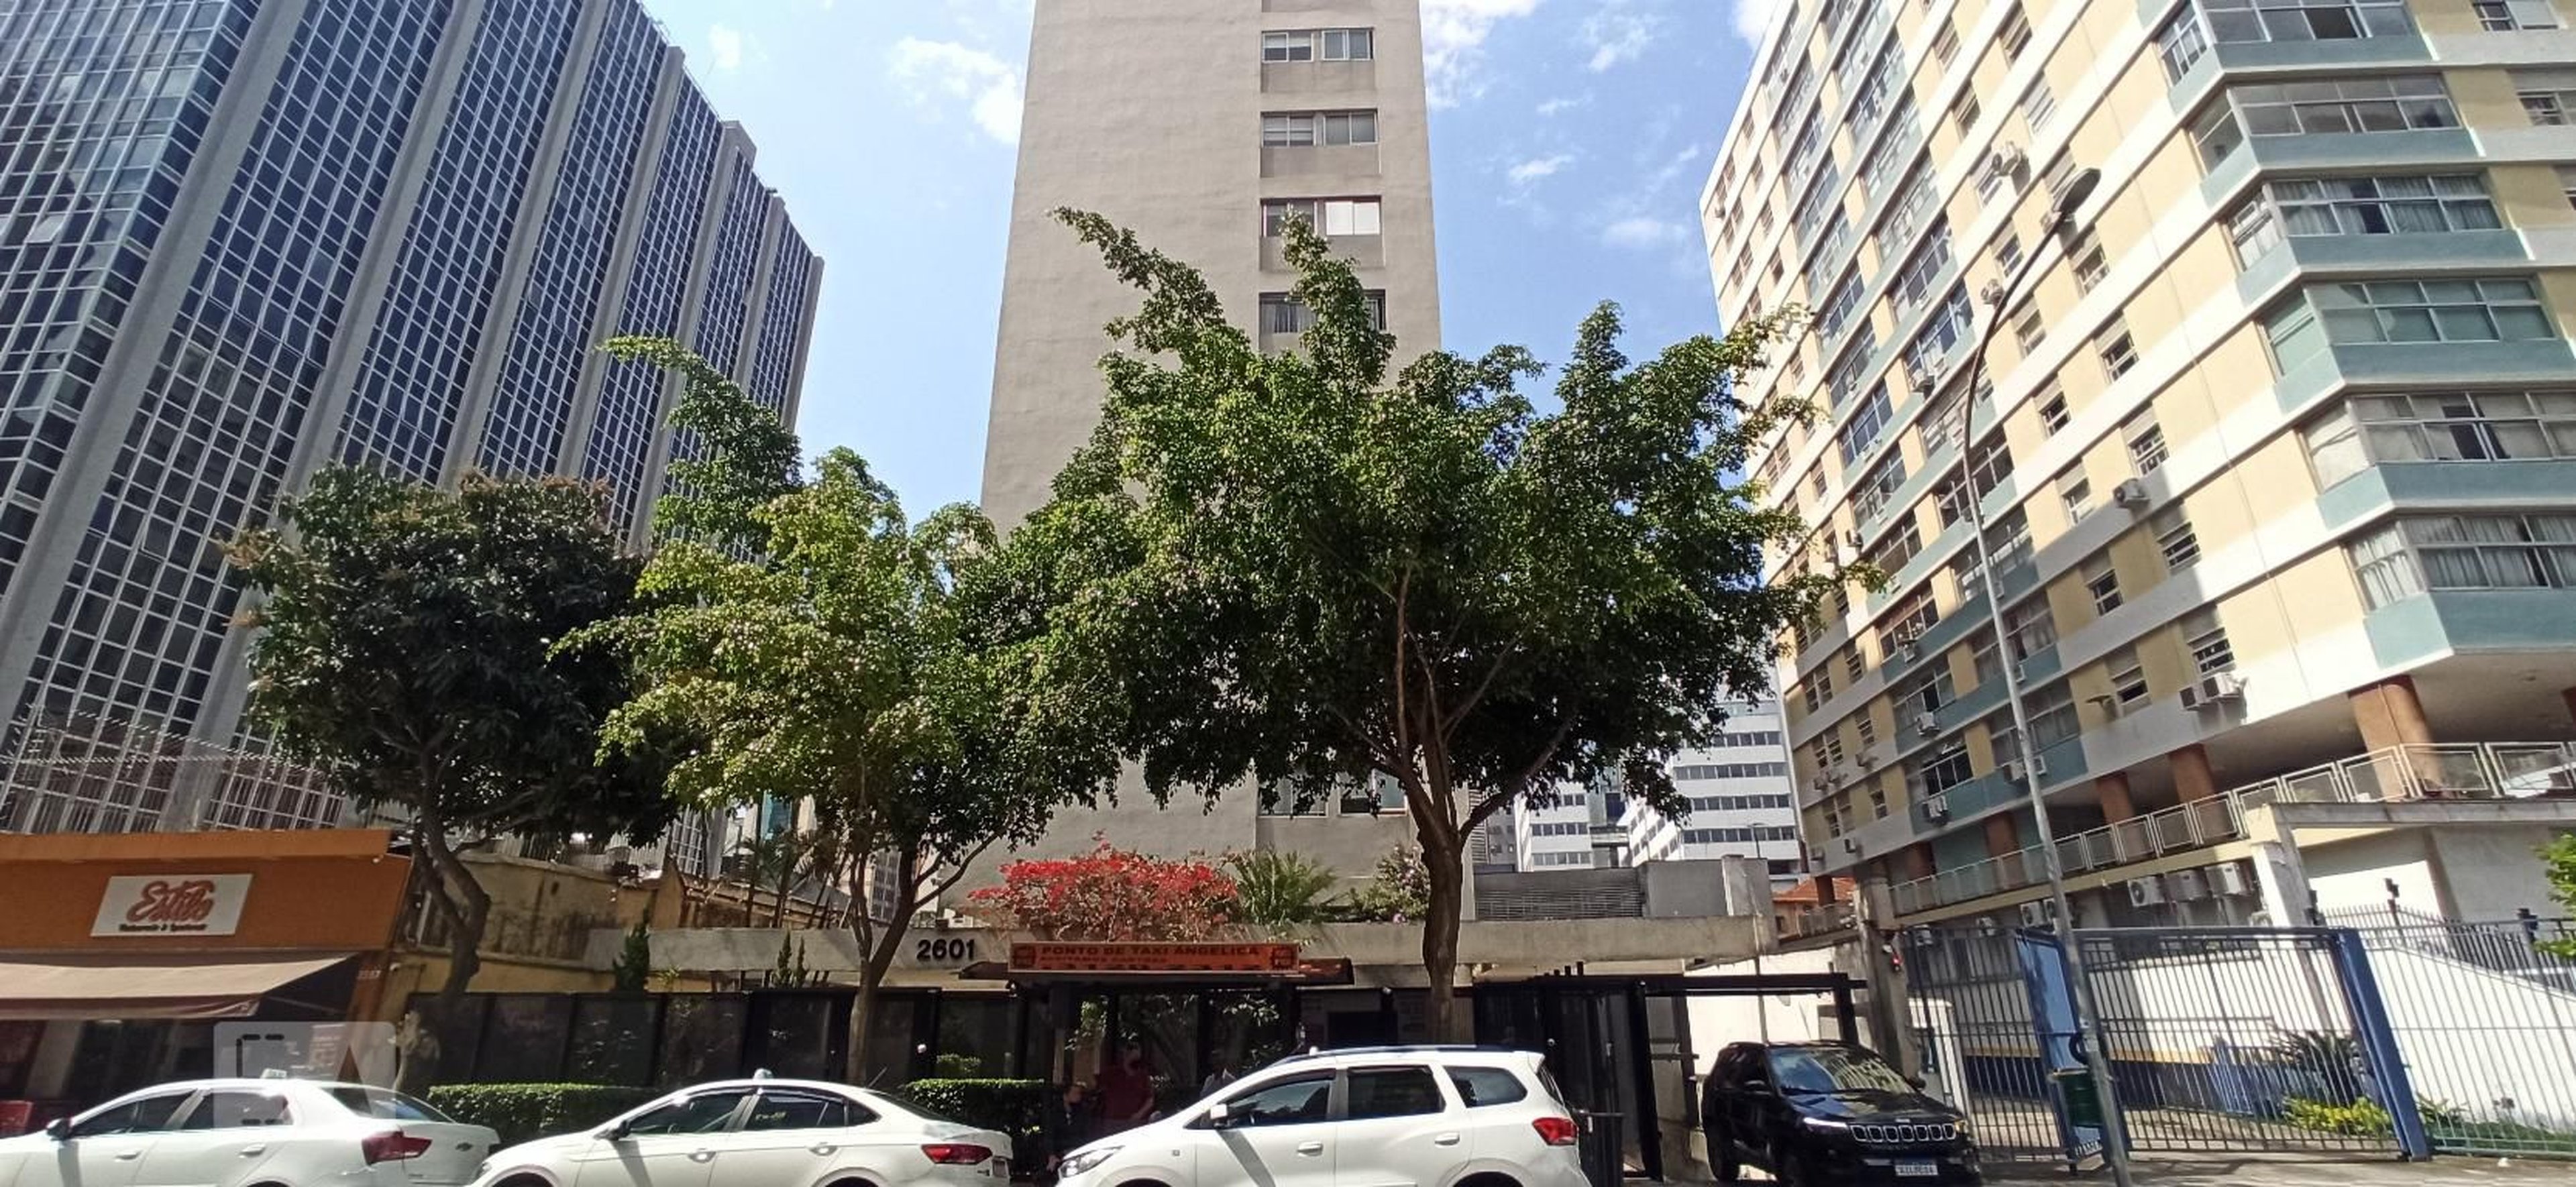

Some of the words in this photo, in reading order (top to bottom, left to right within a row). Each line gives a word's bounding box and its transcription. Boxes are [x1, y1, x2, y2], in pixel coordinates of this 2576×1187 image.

[916, 939, 975, 961] 2601
[1041, 946, 1099, 955] PONTO
[1104, 946, 1125, 955] DE
[1132, 946, 1169, 955] TAXI
